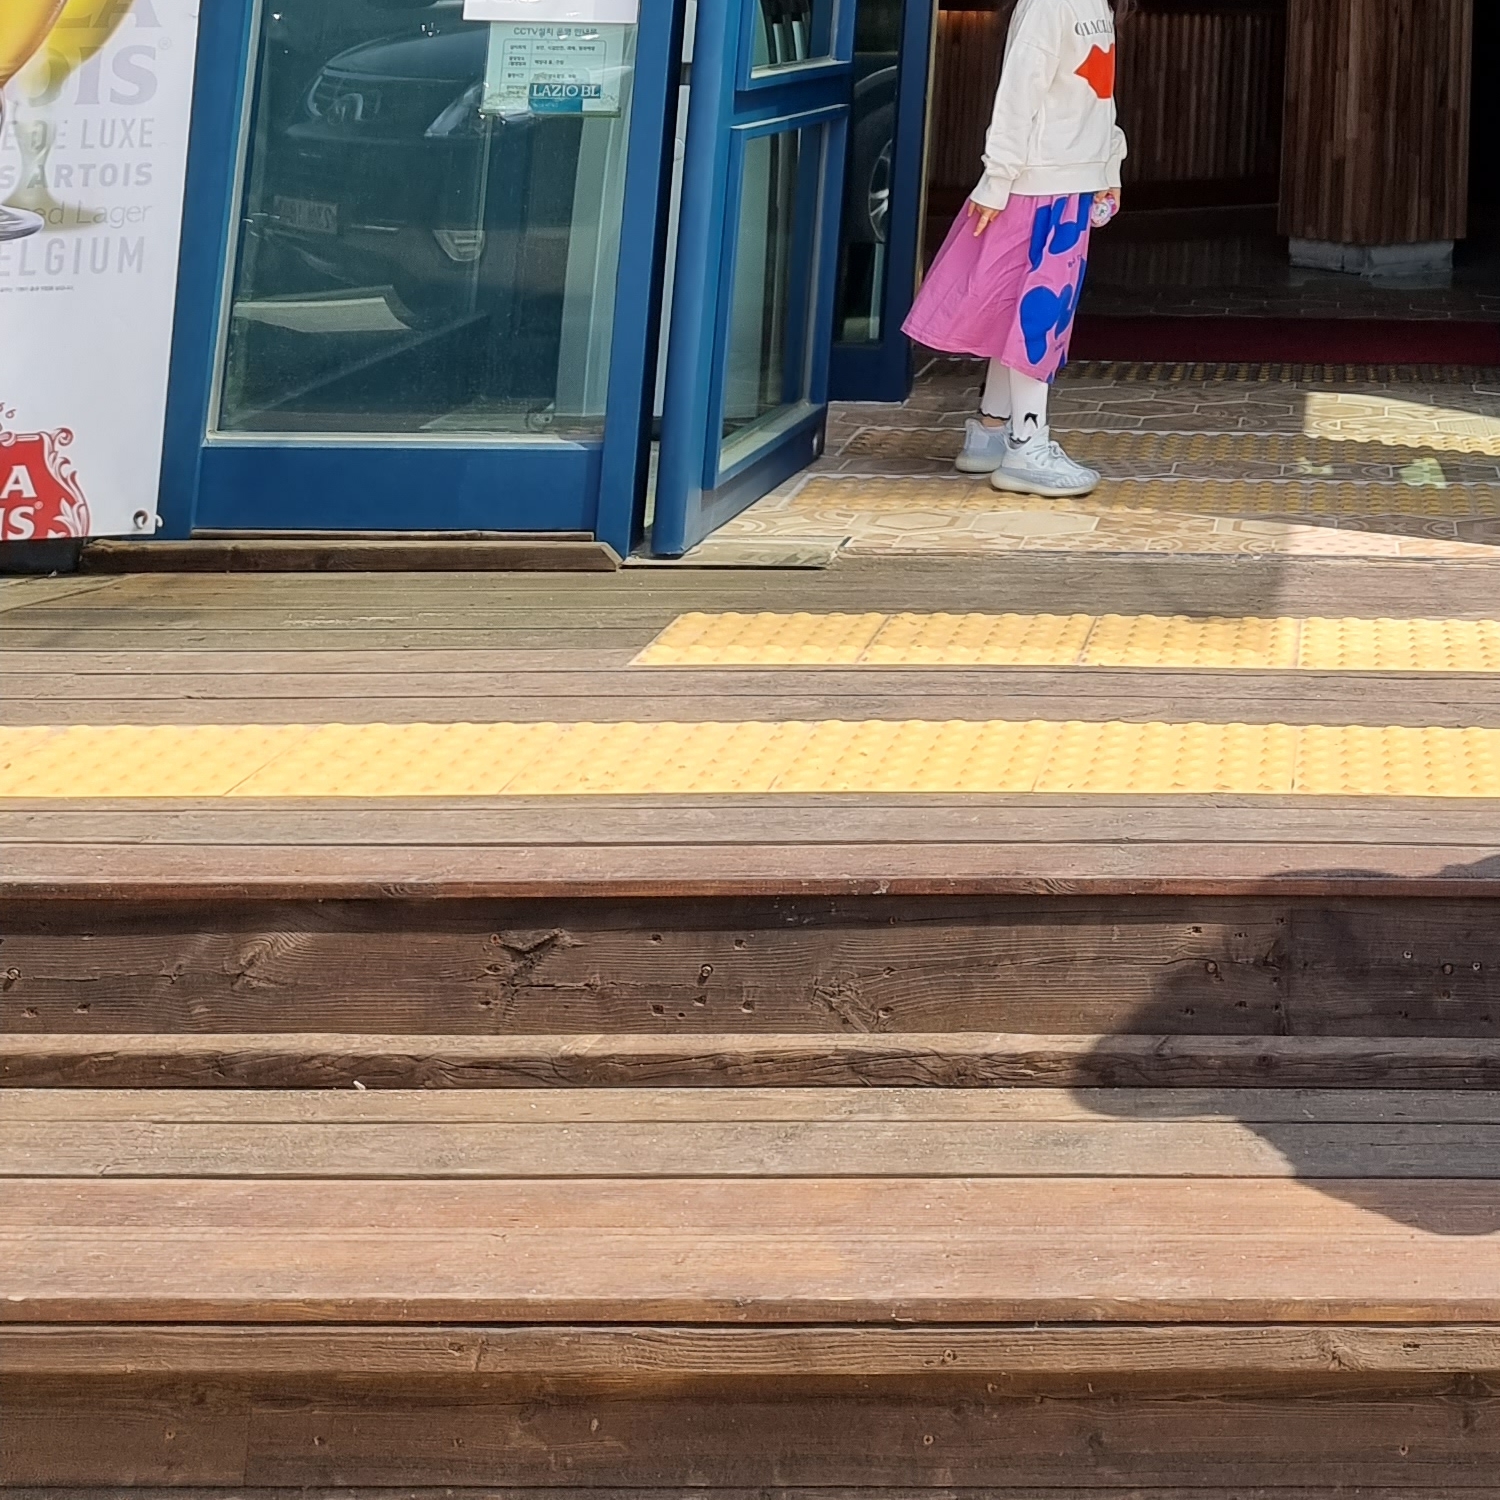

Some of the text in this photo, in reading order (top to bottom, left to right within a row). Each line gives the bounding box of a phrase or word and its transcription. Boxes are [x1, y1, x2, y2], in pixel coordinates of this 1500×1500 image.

[533, 85, 579, 97] LAZIO
[581, 85, 600, 97] BL
[80, 118, 155, 149] LUXE
[27, 162, 153, 189] ARTOIS
[76, 200, 153, 229] Lager
